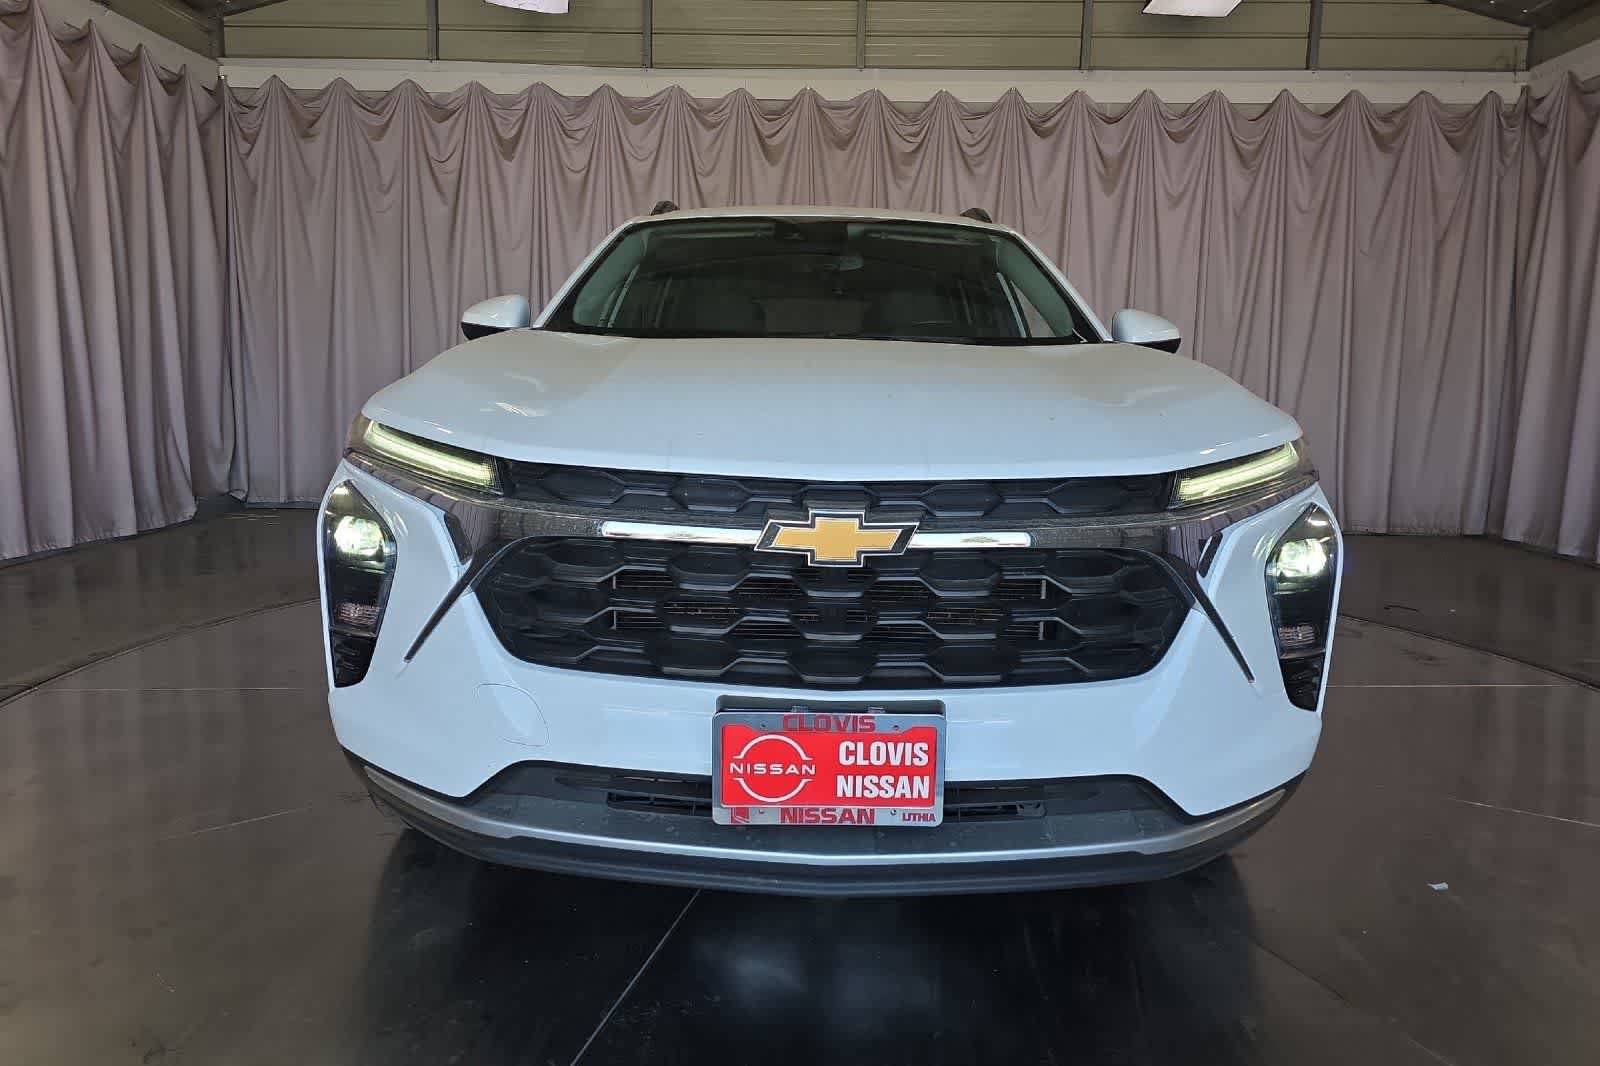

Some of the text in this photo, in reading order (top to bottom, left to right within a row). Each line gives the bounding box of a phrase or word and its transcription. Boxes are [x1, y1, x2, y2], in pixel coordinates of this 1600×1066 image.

[782, 714, 876, 733] CLOVIS
[839, 741, 930, 767] CLOVIS
[729, 762, 816, 776] NISSAN
[836, 775, 930, 799] NISSAN
[780, 807, 876, 825] NISSAN
[902, 811, 937, 823] LITHIA
